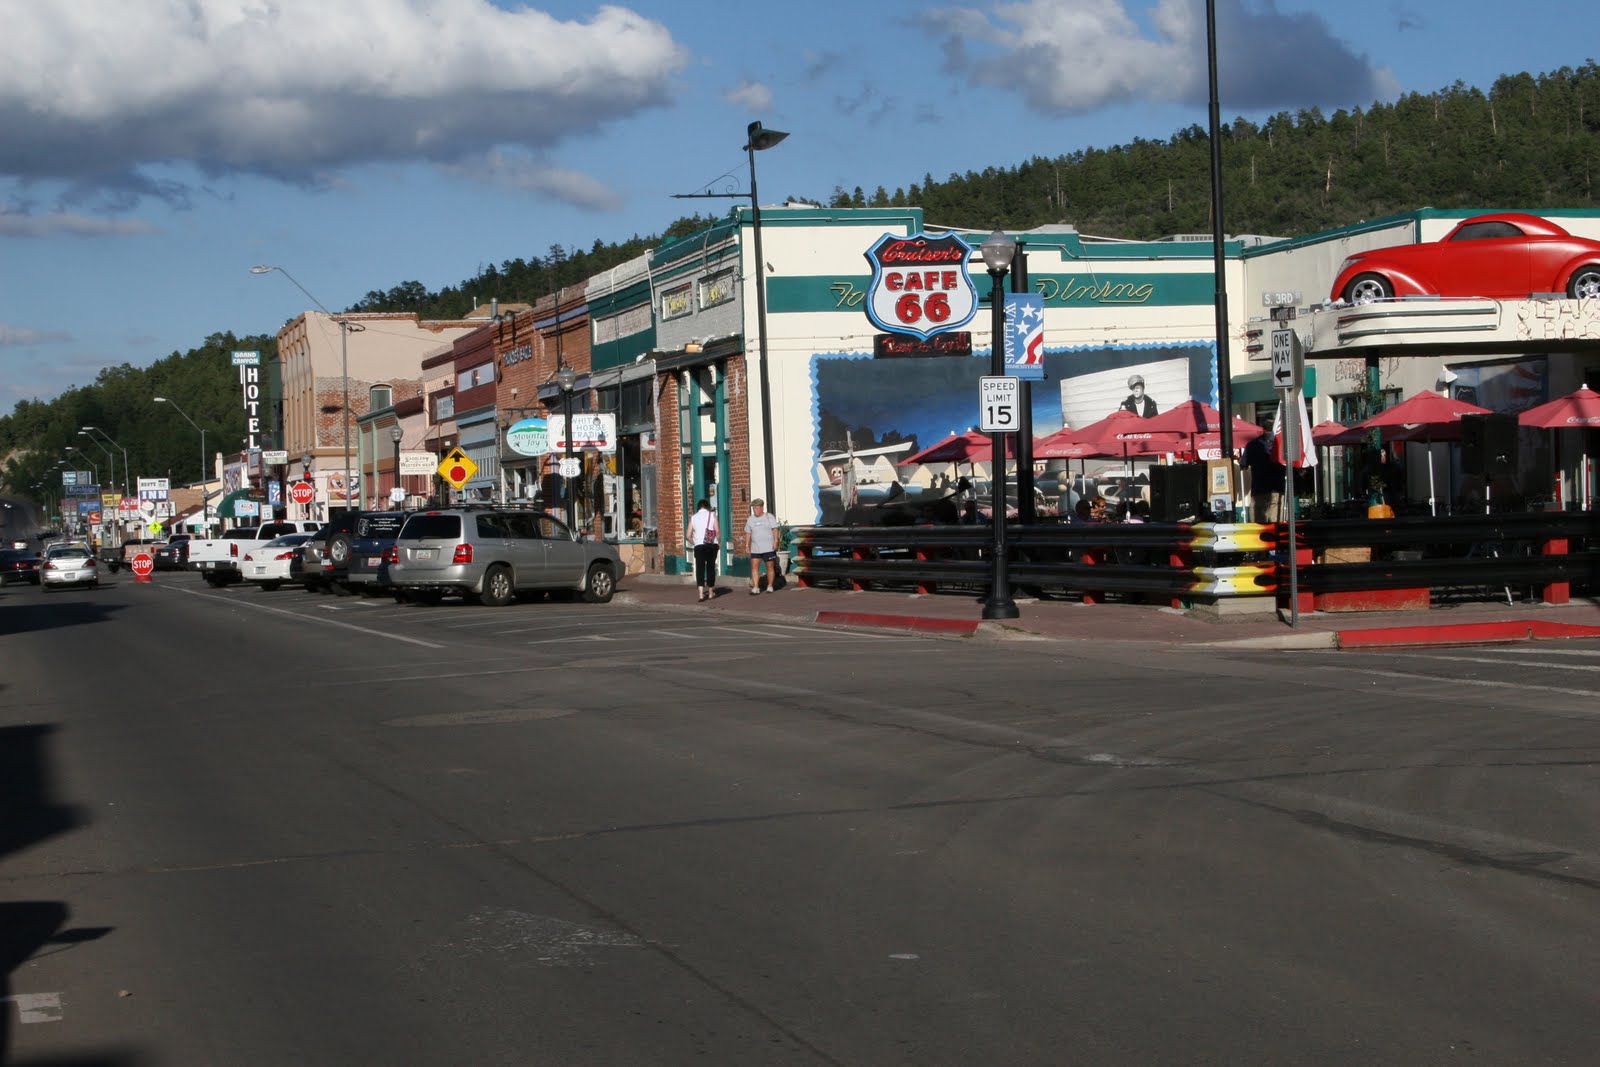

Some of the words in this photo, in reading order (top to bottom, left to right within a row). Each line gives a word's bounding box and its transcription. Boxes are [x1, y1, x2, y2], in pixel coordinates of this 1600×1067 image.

[882, 239, 962, 262] Cruiser's
[884, 271, 958, 291] CAFE
[1275, 292, 1293, 304] 3RD
[895, 292, 951, 324] 66
[1005, 302, 1017, 364] WILLIAMS
[1273, 333, 1290, 347] ONE
[1273, 350, 1290, 364] WAY
[983, 383, 1015, 391] SPEED
[987, 394, 1011, 402] LIMIT
[247, 368, 260, 449] HOTEL
[987, 406, 1012, 425] 15
[565, 467, 576, 475] 66
[142, 491, 167, 499] INN
[293, 489, 312, 498] STOP
[133, 560, 152, 569] STOP
